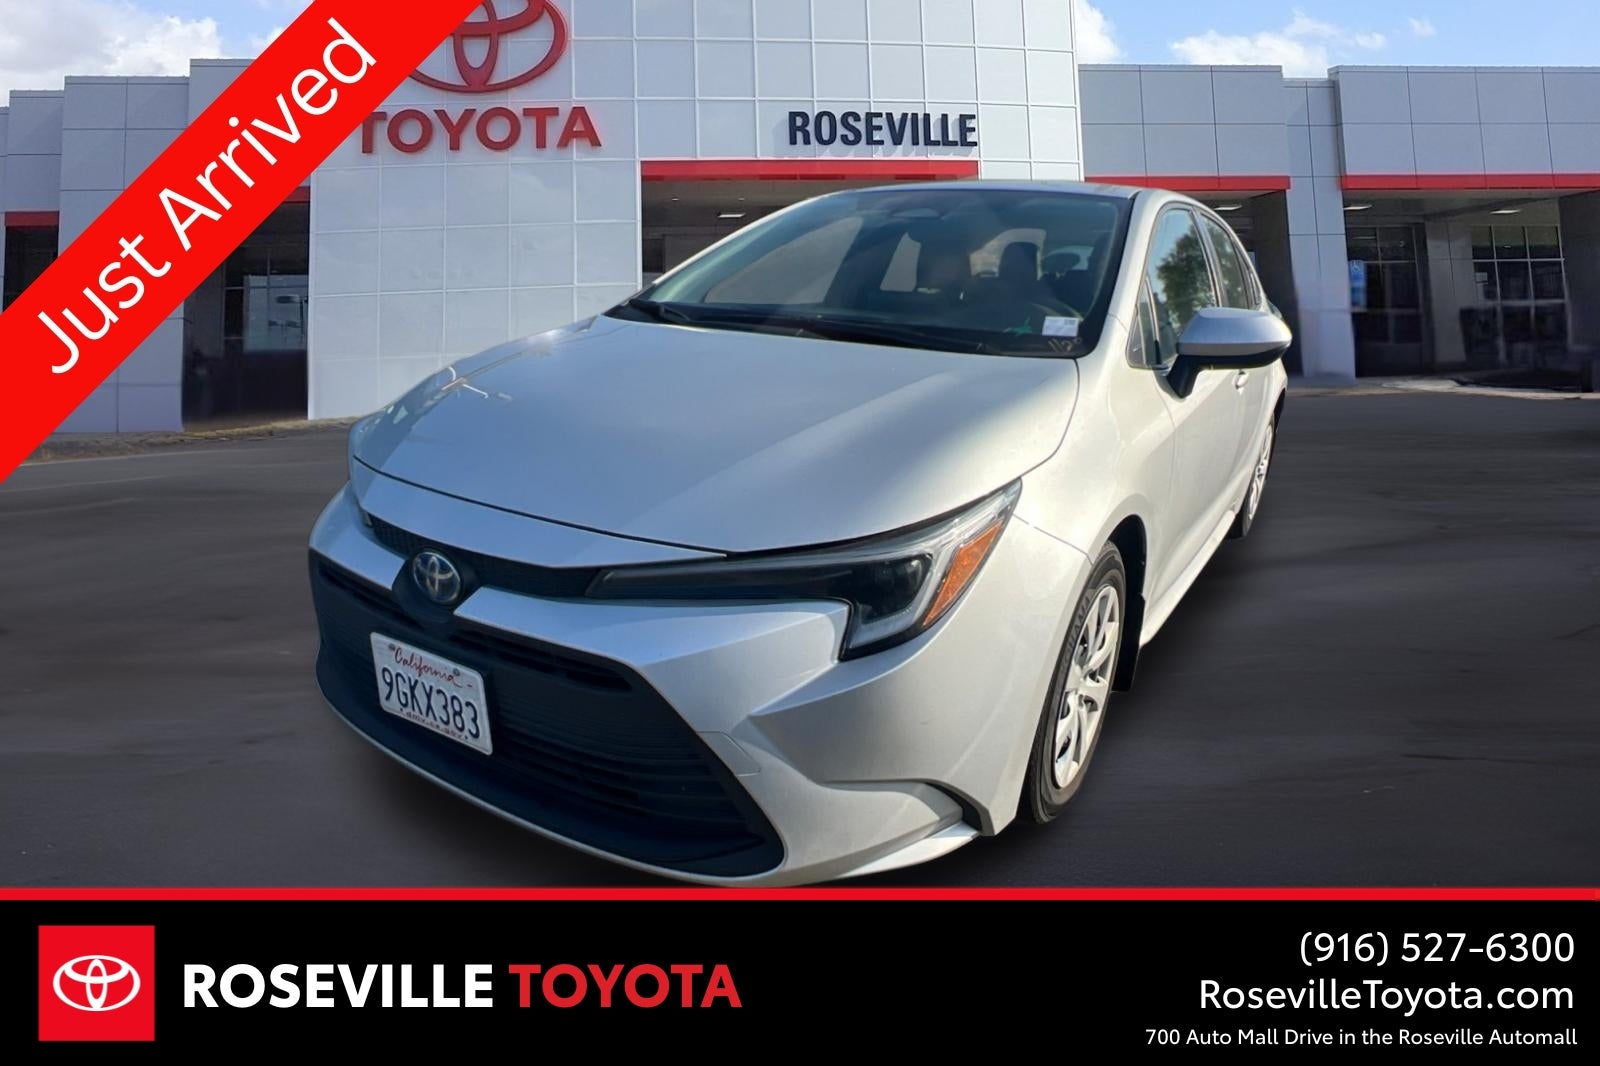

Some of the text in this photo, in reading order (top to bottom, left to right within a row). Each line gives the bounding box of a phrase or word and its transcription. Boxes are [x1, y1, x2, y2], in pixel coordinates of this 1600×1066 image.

[360, 106, 602, 154] TOYOTA
[788, 111, 978, 147] ROSEVILLE
[394, 647, 463, 688] California
[382, 667, 480, 740] 9GKX383
